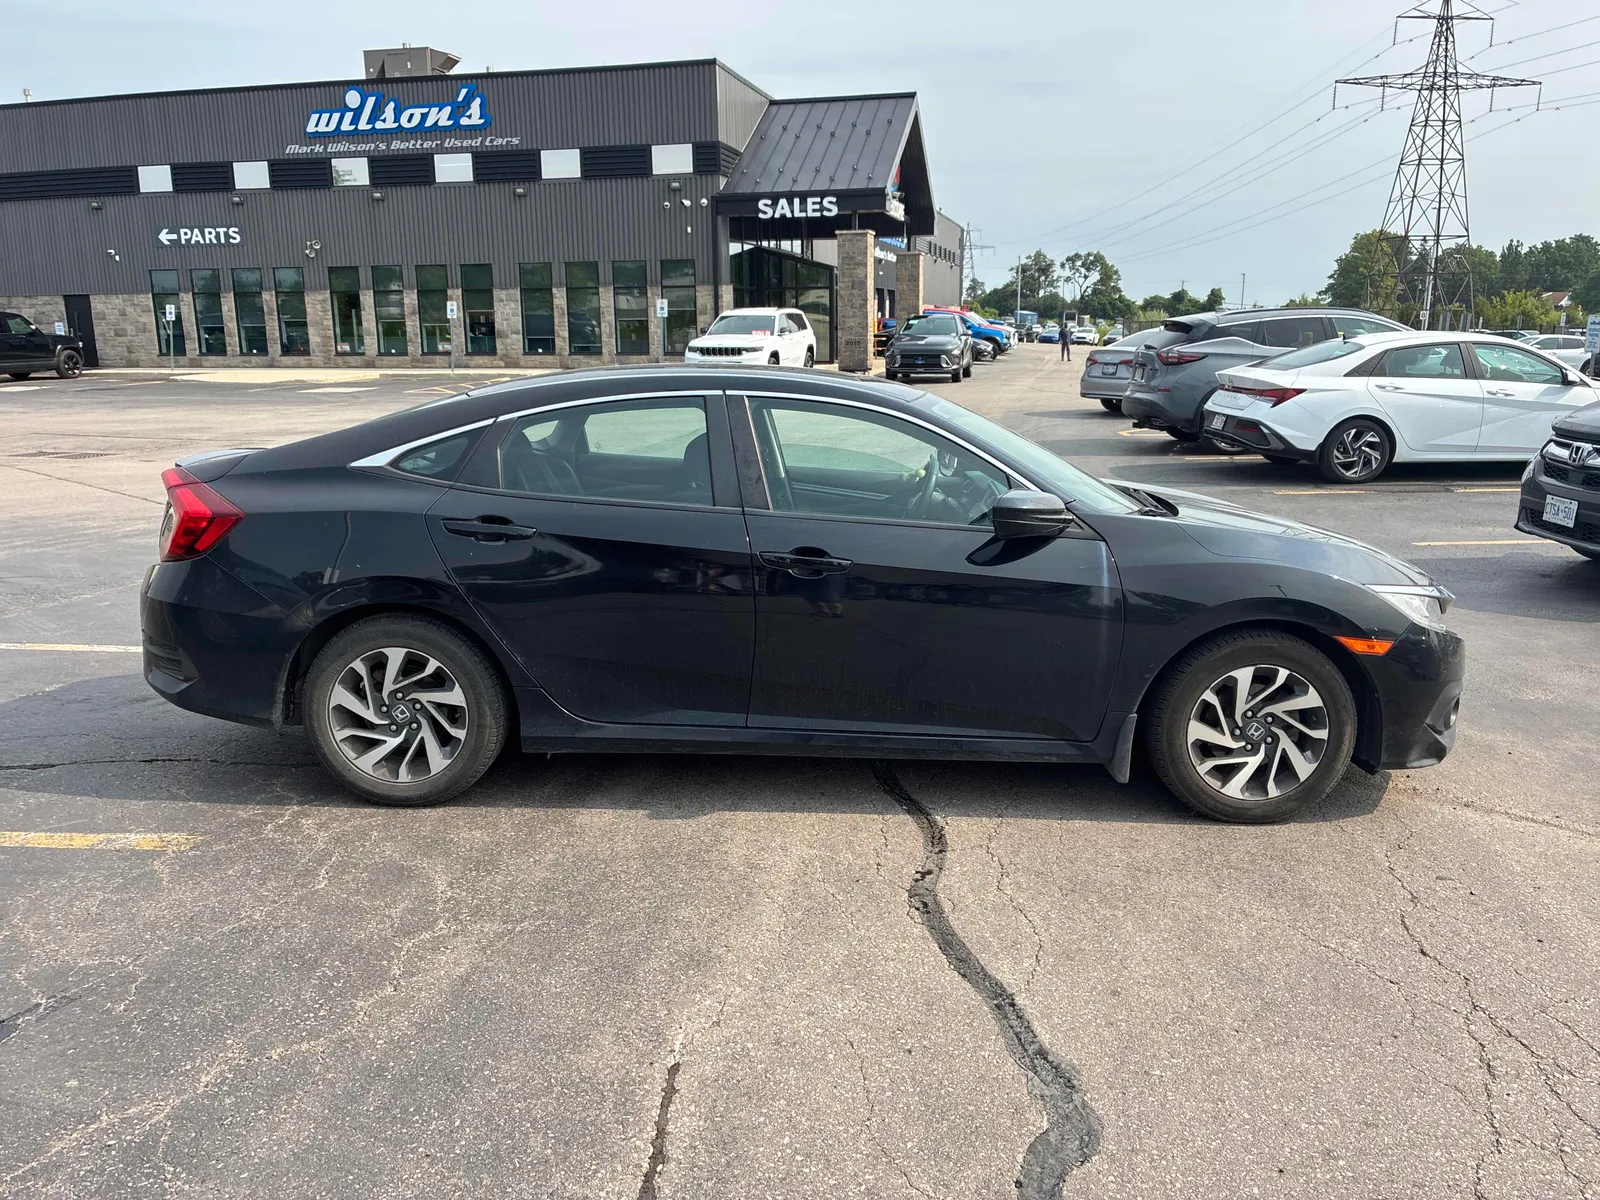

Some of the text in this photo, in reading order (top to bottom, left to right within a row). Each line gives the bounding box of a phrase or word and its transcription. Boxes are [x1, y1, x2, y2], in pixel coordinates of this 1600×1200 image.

[306, 87, 486, 133] wilson's
[285, 136, 521, 154] Mark Wilson's Better Used Cars
[757, 196, 839, 219] SALES
[180, 227, 241, 244] PARTS
